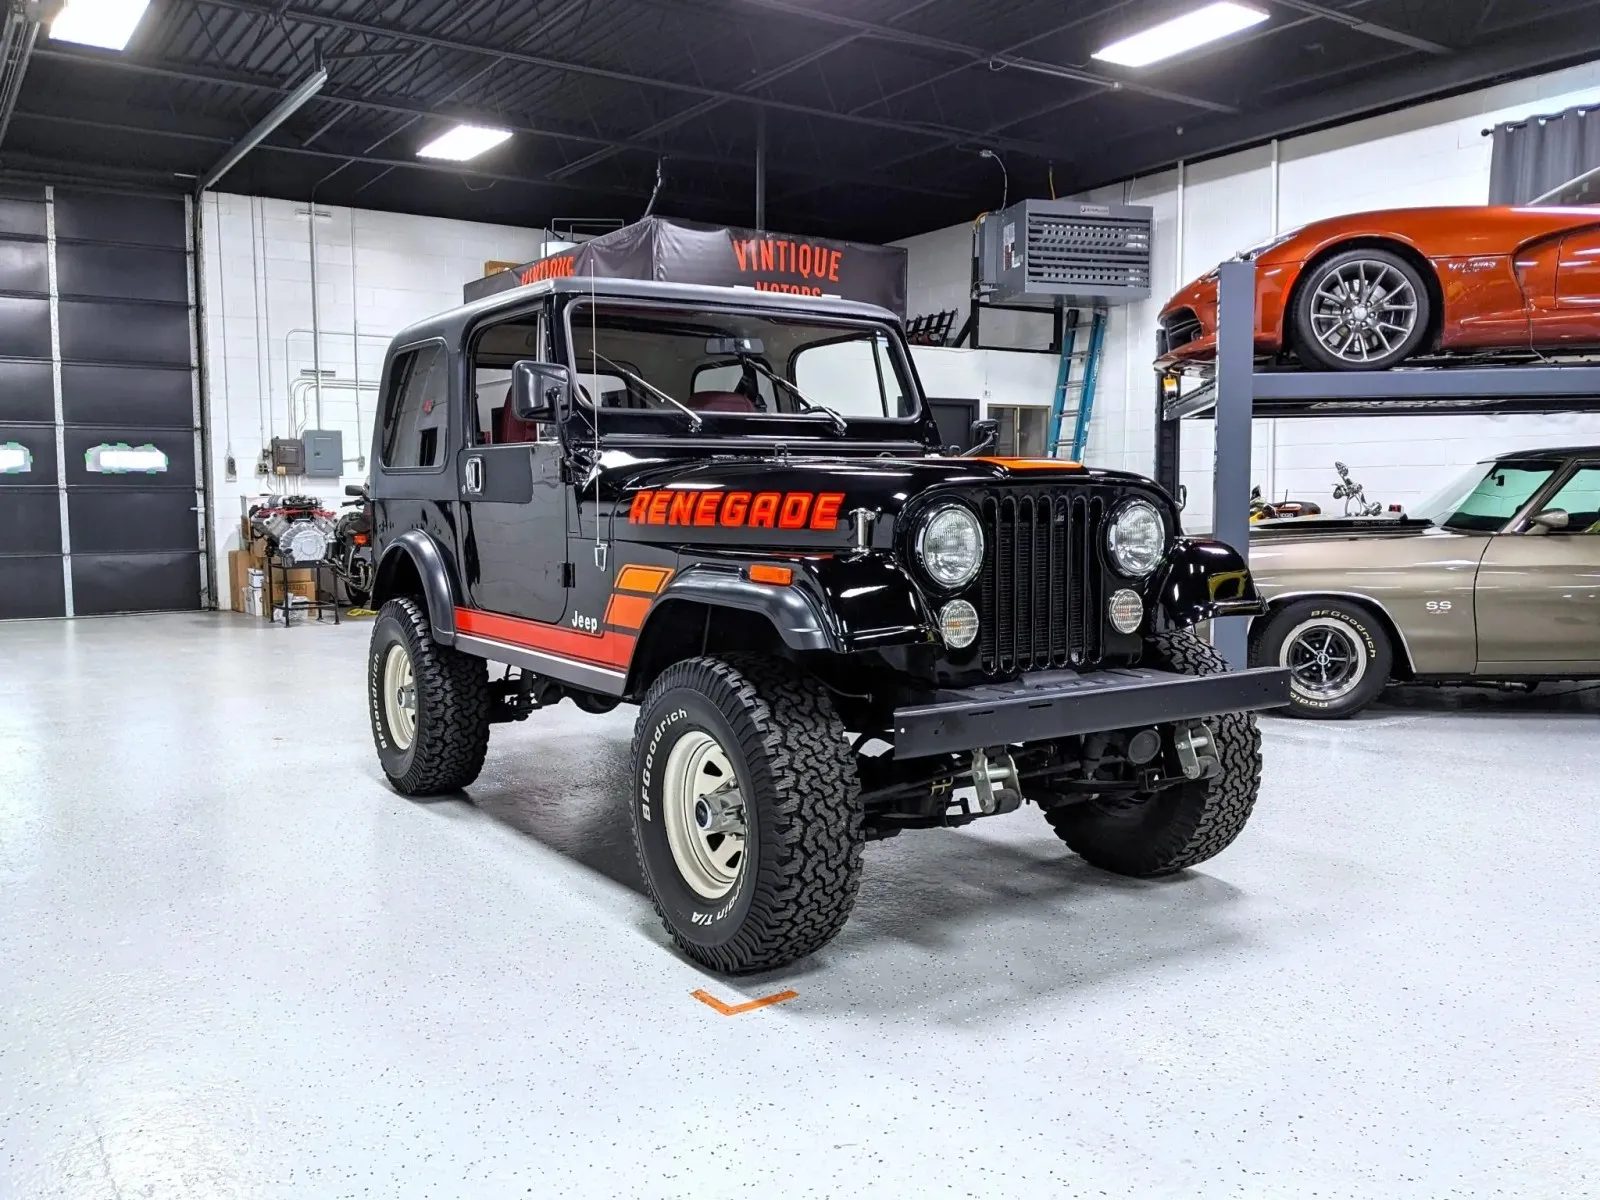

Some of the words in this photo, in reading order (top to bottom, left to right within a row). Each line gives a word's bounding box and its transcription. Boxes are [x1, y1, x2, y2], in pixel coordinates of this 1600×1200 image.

[733, 239, 842, 282] VINTIQUE
[628, 491, 846, 530] RENEGADE
[571, 610, 598, 634] Jeep
[1425, 600, 1452, 610] SS
[1311, 609, 1377, 658] BFGoodrich
[371, 652, 388, 750] BFGoodrich
[642, 708, 688, 822] BFGoodrich
[691, 911, 713, 926] T/A
